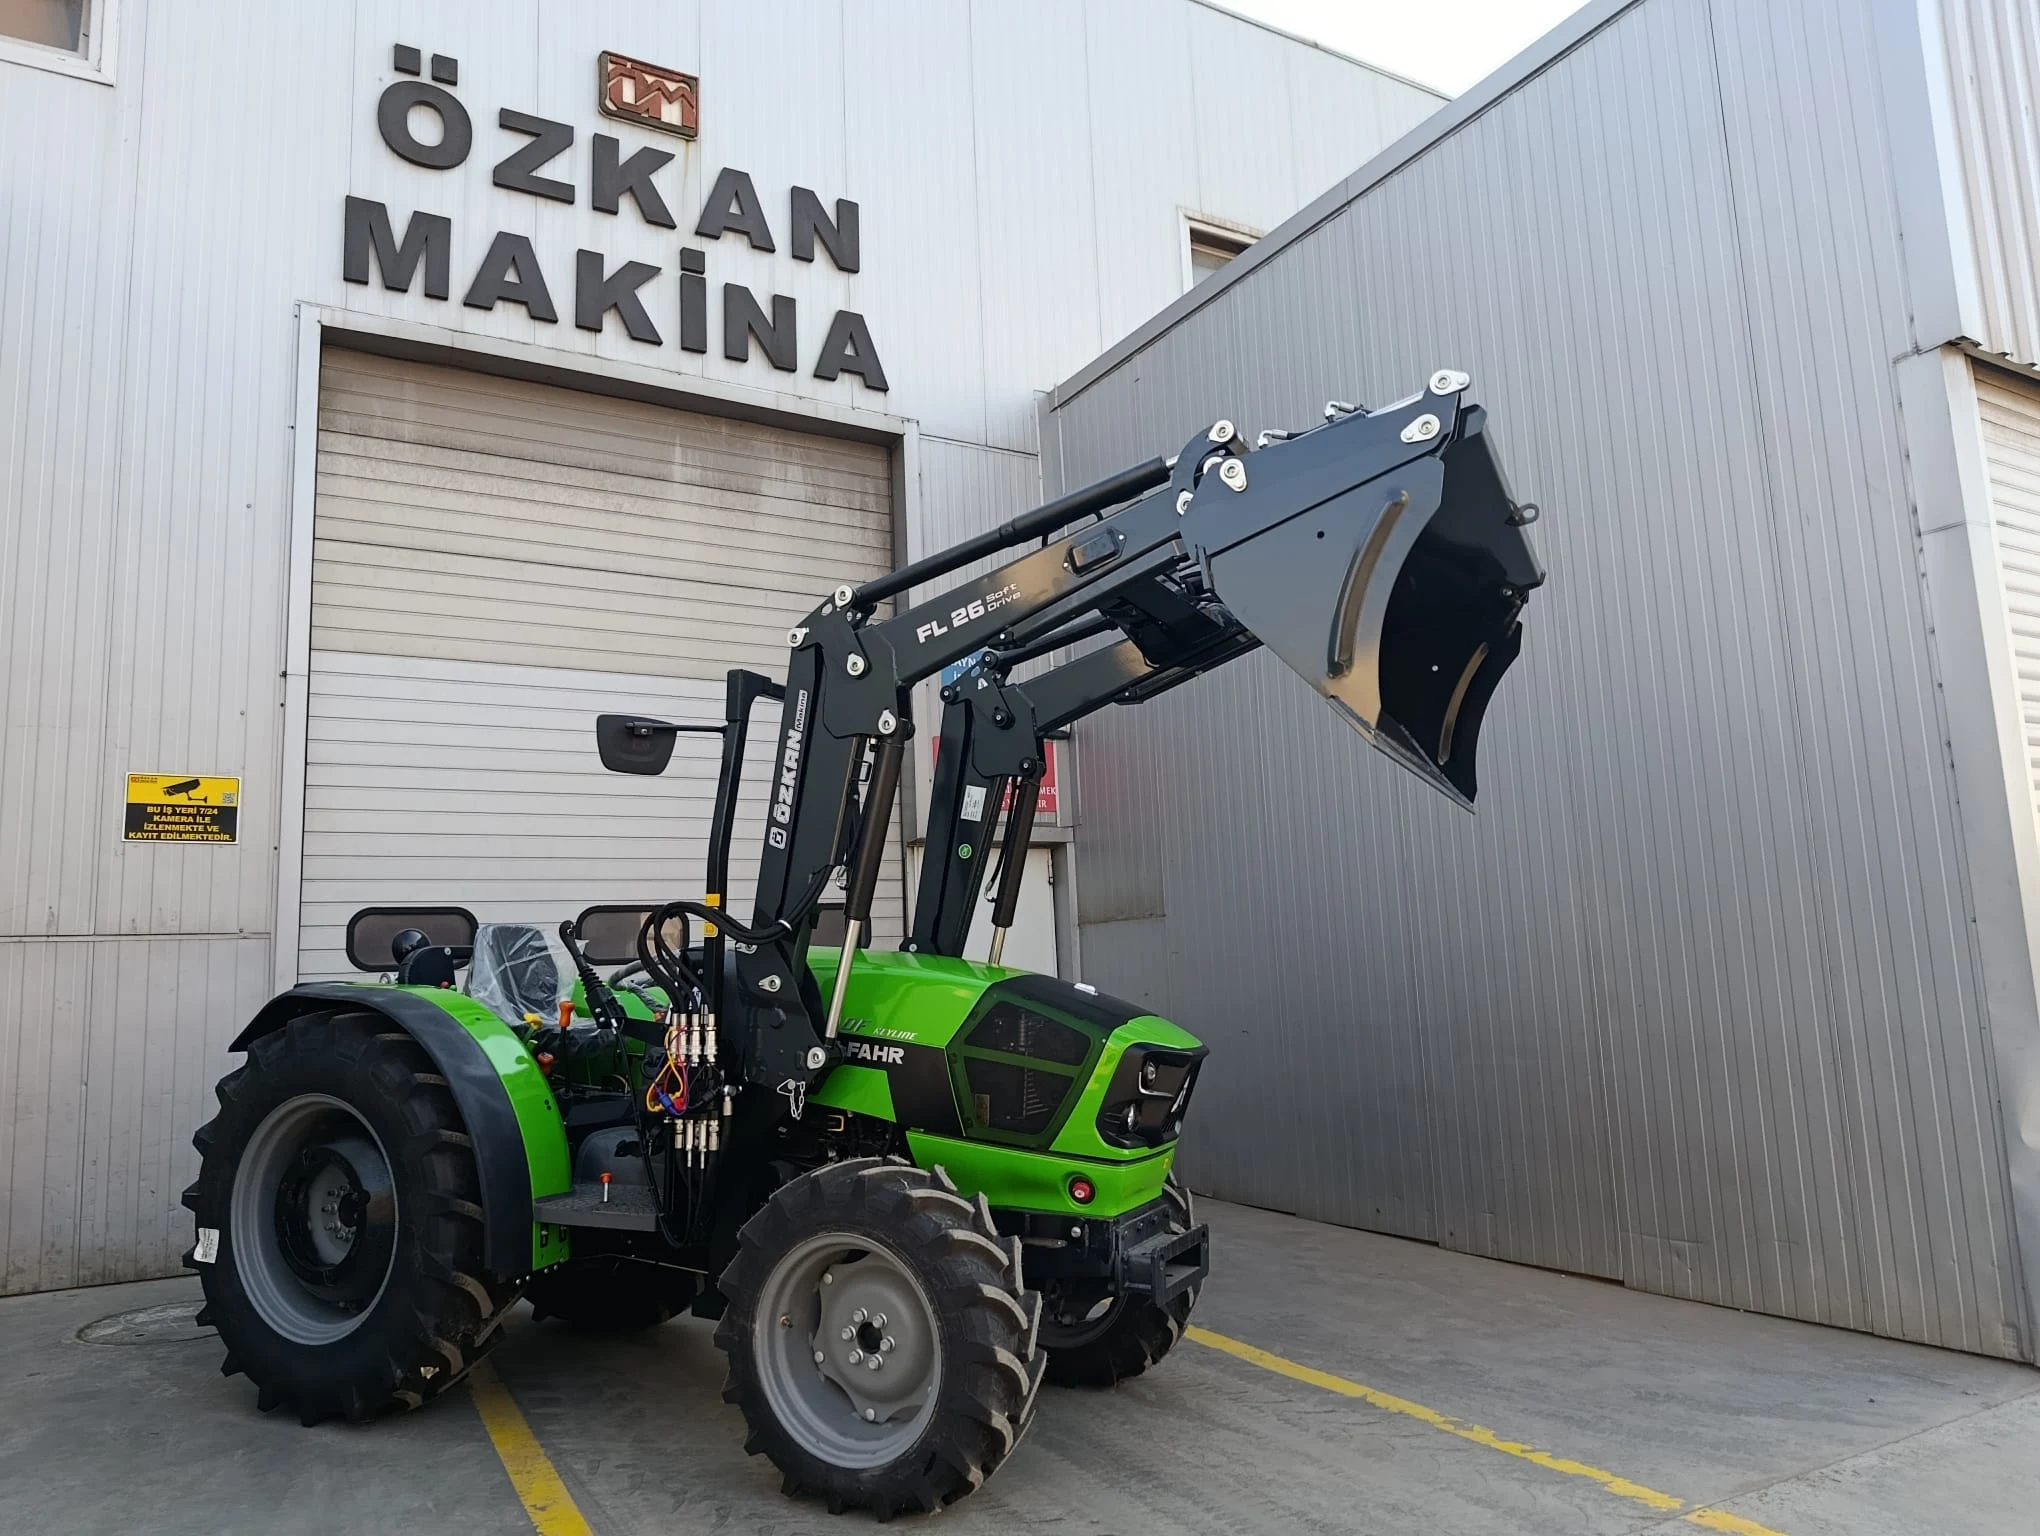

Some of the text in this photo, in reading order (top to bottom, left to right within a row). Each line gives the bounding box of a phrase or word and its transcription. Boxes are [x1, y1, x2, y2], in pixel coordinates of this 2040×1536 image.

[378, 42, 860, 274] ÖZKAN
[343, 195, 889, 393] MAKİNA
[985, 583, 1017, 603] Soft
[987, 591, 1021, 612] Drive
[916, 599, 985, 644] FL 26
[773, 728, 802, 824] ÖZKAN
[146, 805, 161, 813] BU
[163, 805, 173, 815] İŞ
[175, 806, 197, 814] YERİ
[153, 815, 211, 823] KAMERA İLE
[143, 822, 205, 832] İZLENMEKTE
[846, 1041, 905, 1065] FAHR
